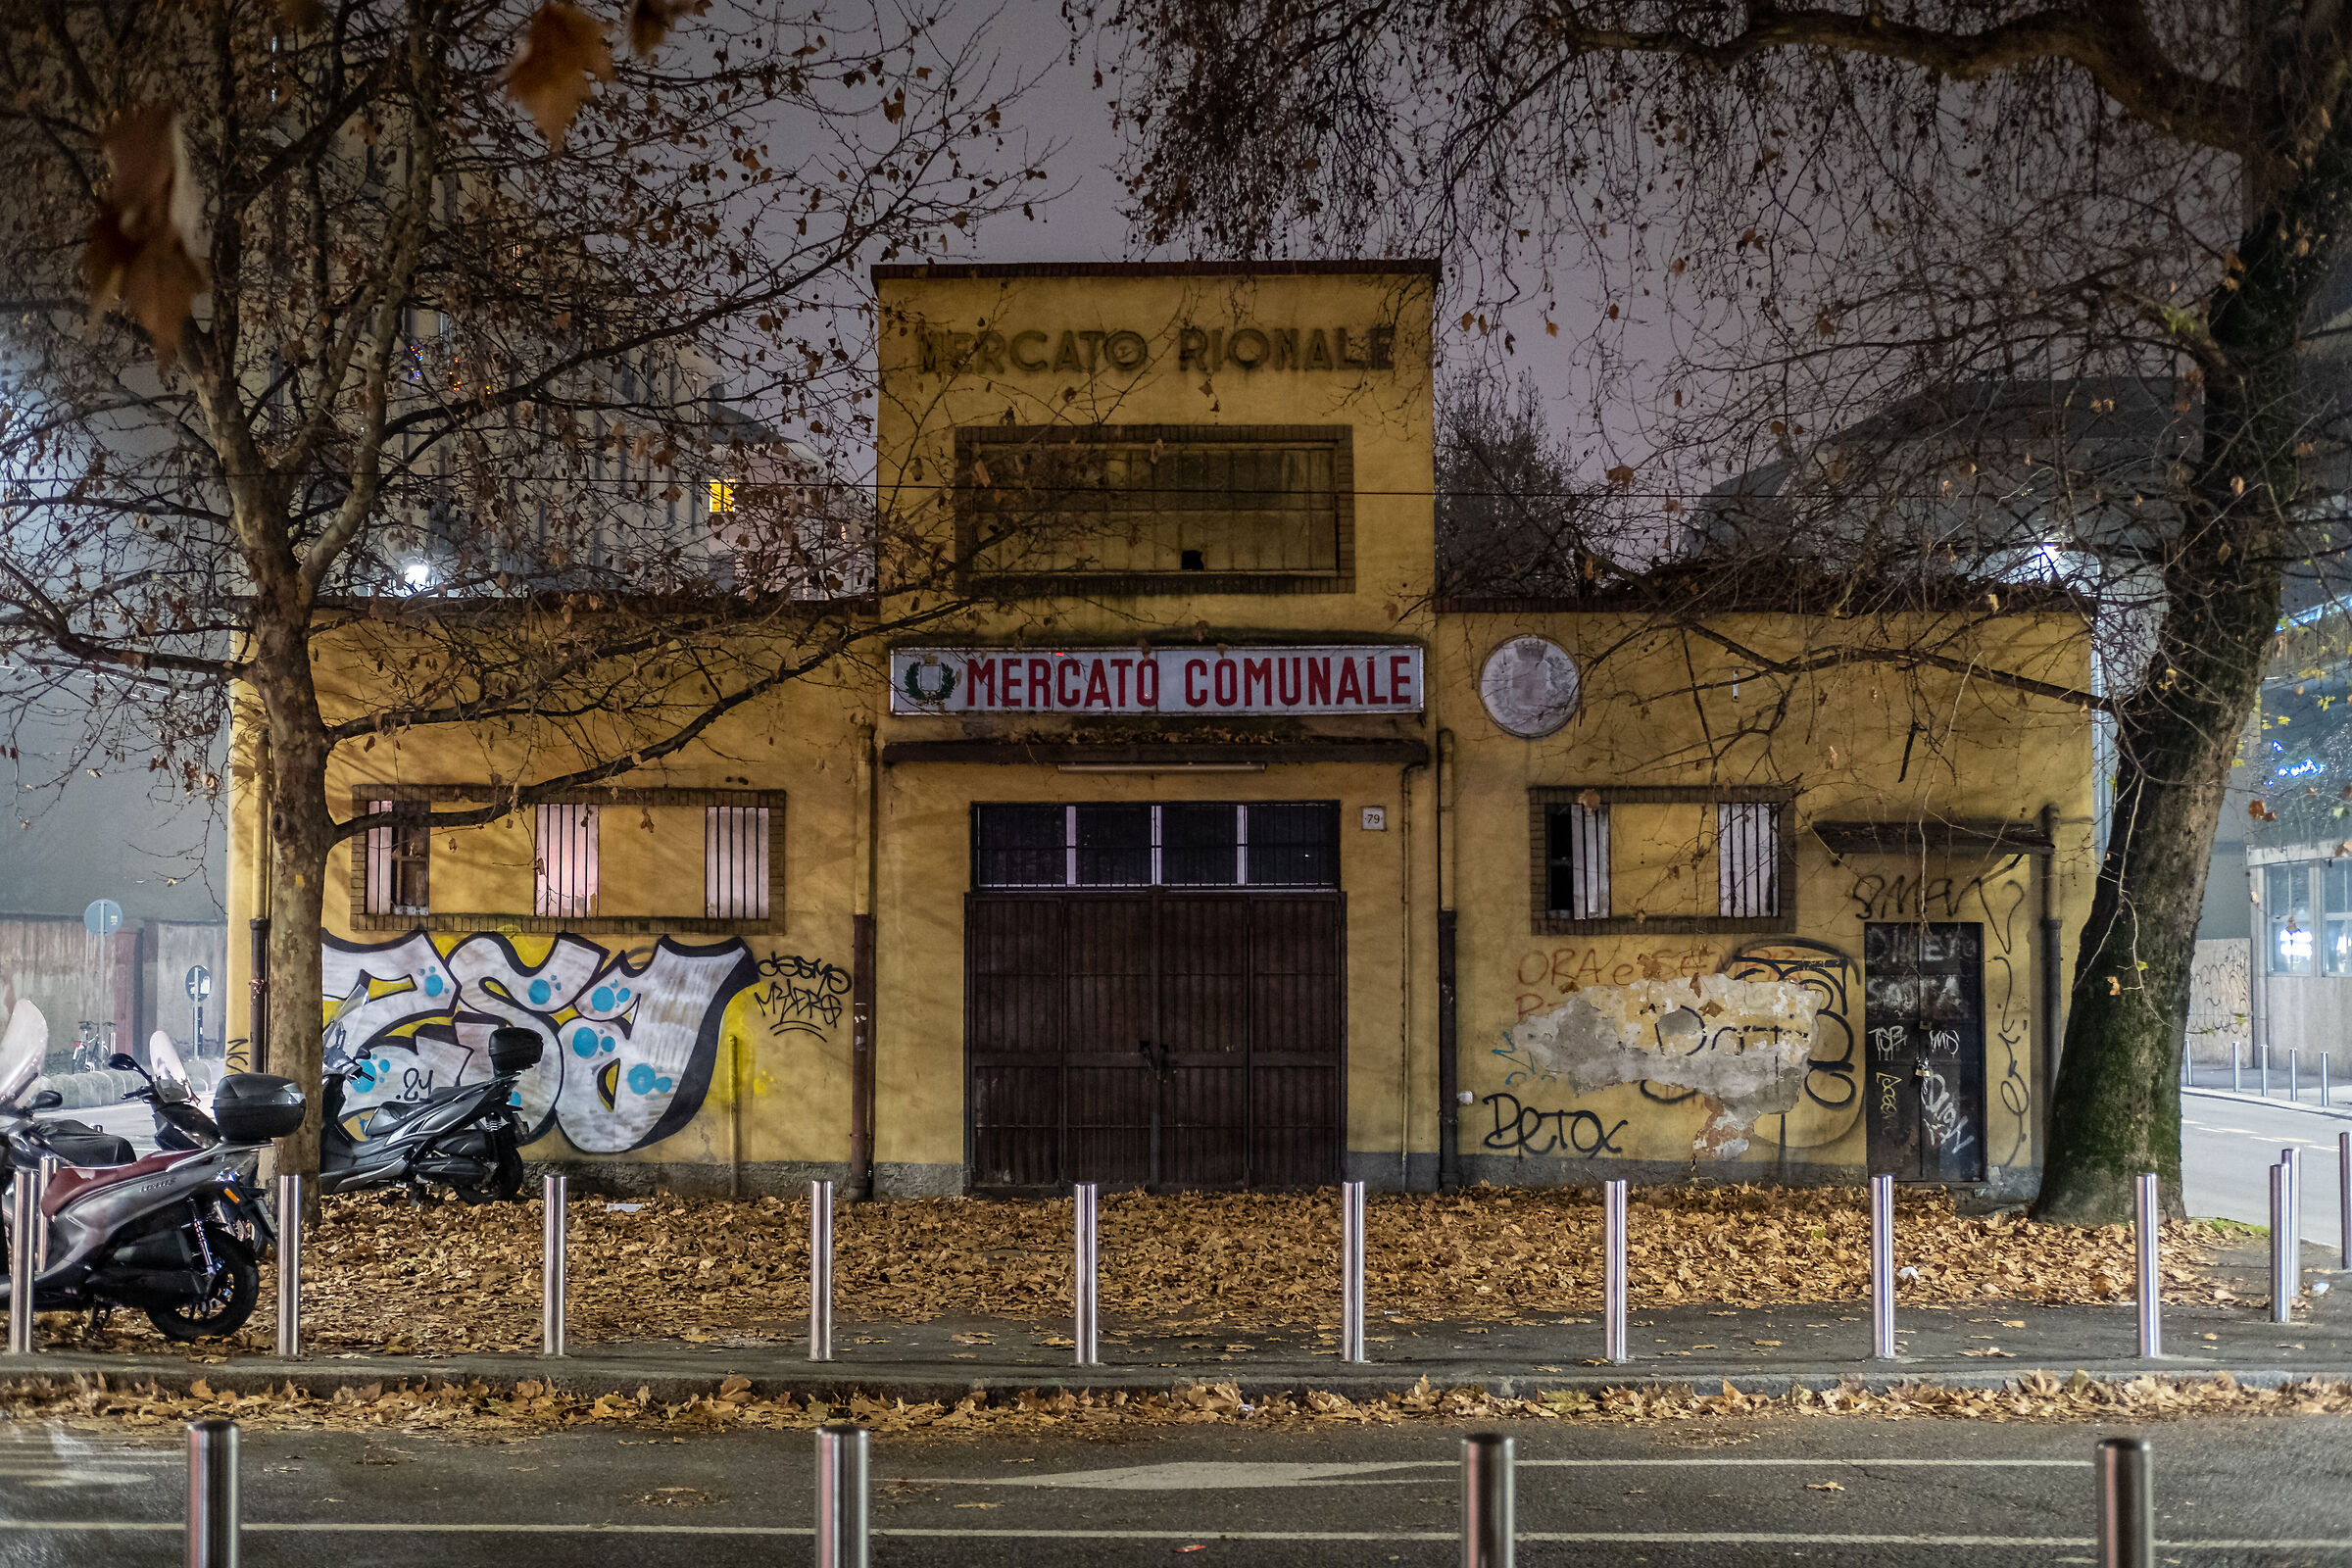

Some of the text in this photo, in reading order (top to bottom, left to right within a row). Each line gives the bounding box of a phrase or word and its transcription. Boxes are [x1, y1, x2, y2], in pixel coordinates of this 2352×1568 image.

[1179, 327, 1396, 372] RIONALE
[966, 656, 1412, 708] MERCATO COMUNALE
[1367, 813, 1381, 824] 79
[1518, 949, 1600, 986] ORA
